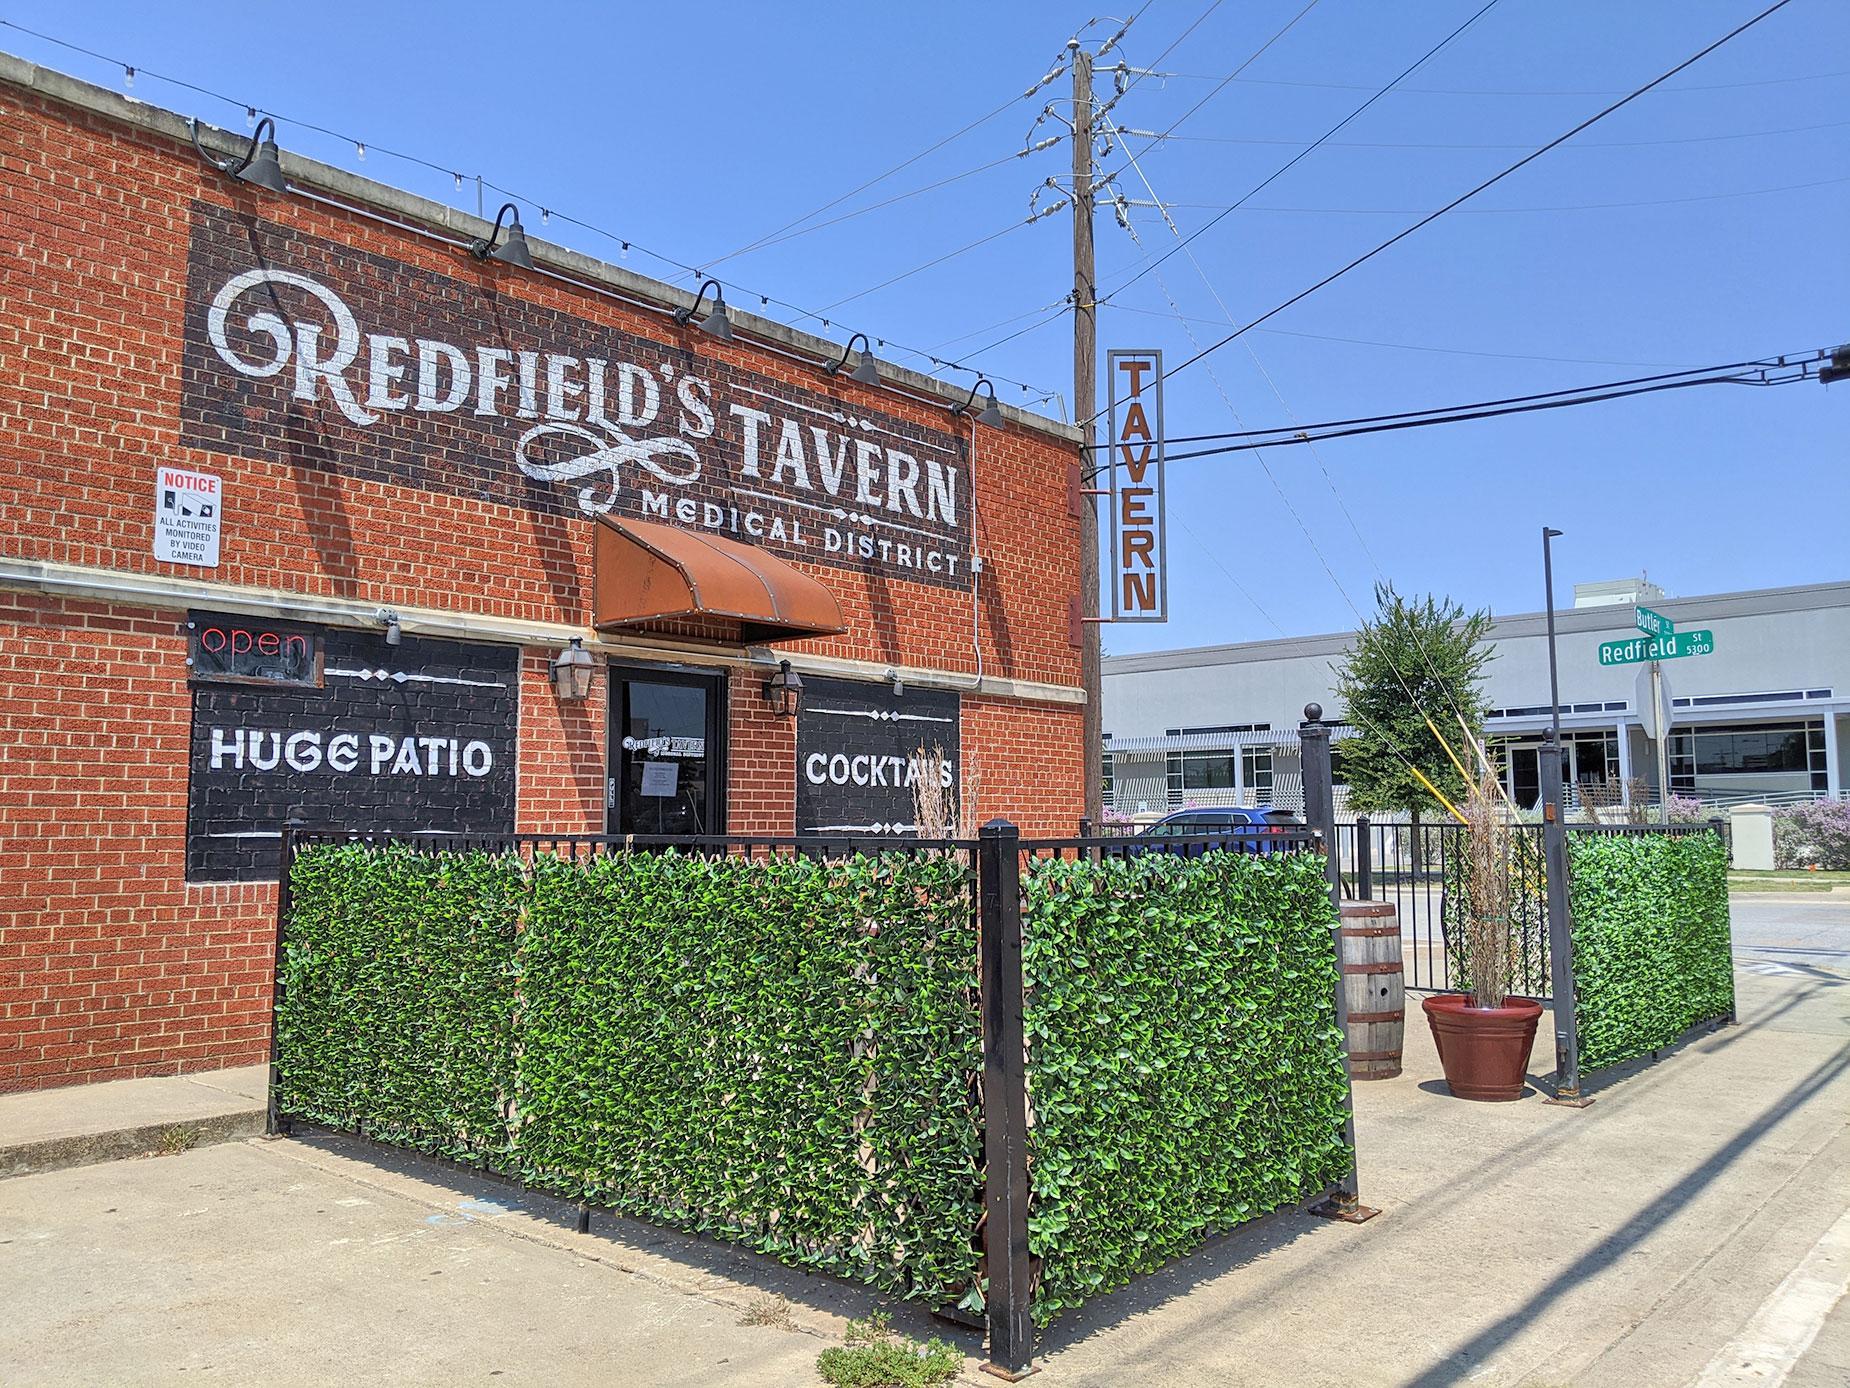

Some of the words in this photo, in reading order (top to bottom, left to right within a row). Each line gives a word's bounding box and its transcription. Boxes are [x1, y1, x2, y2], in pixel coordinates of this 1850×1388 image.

[729, 403, 959, 528] TAVERN
[164, 472, 216, 493] NOTICE
[1119, 361, 1156, 611] TAVERN
[159, 517, 174, 526] ALL
[176, 519, 217, 532] ACTIVITIES
[165, 528, 211, 542] MONITORED
[170, 539, 181, 549] BY
[182, 541, 206, 552] VIDEO
[171, 550, 204, 562] CAMERA
[824, 527, 959, 577] DISTRICT
[1636, 609, 1661, 634] Butler
[202, 628, 306, 671] open
[1602, 636, 1677, 663] Redfield
[1692, 632, 1702, 642] St
[1686, 643, 1710, 655] 5300
[210, 729, 359, 772] HUGE
[368, 734, 493, 777] PATIO
